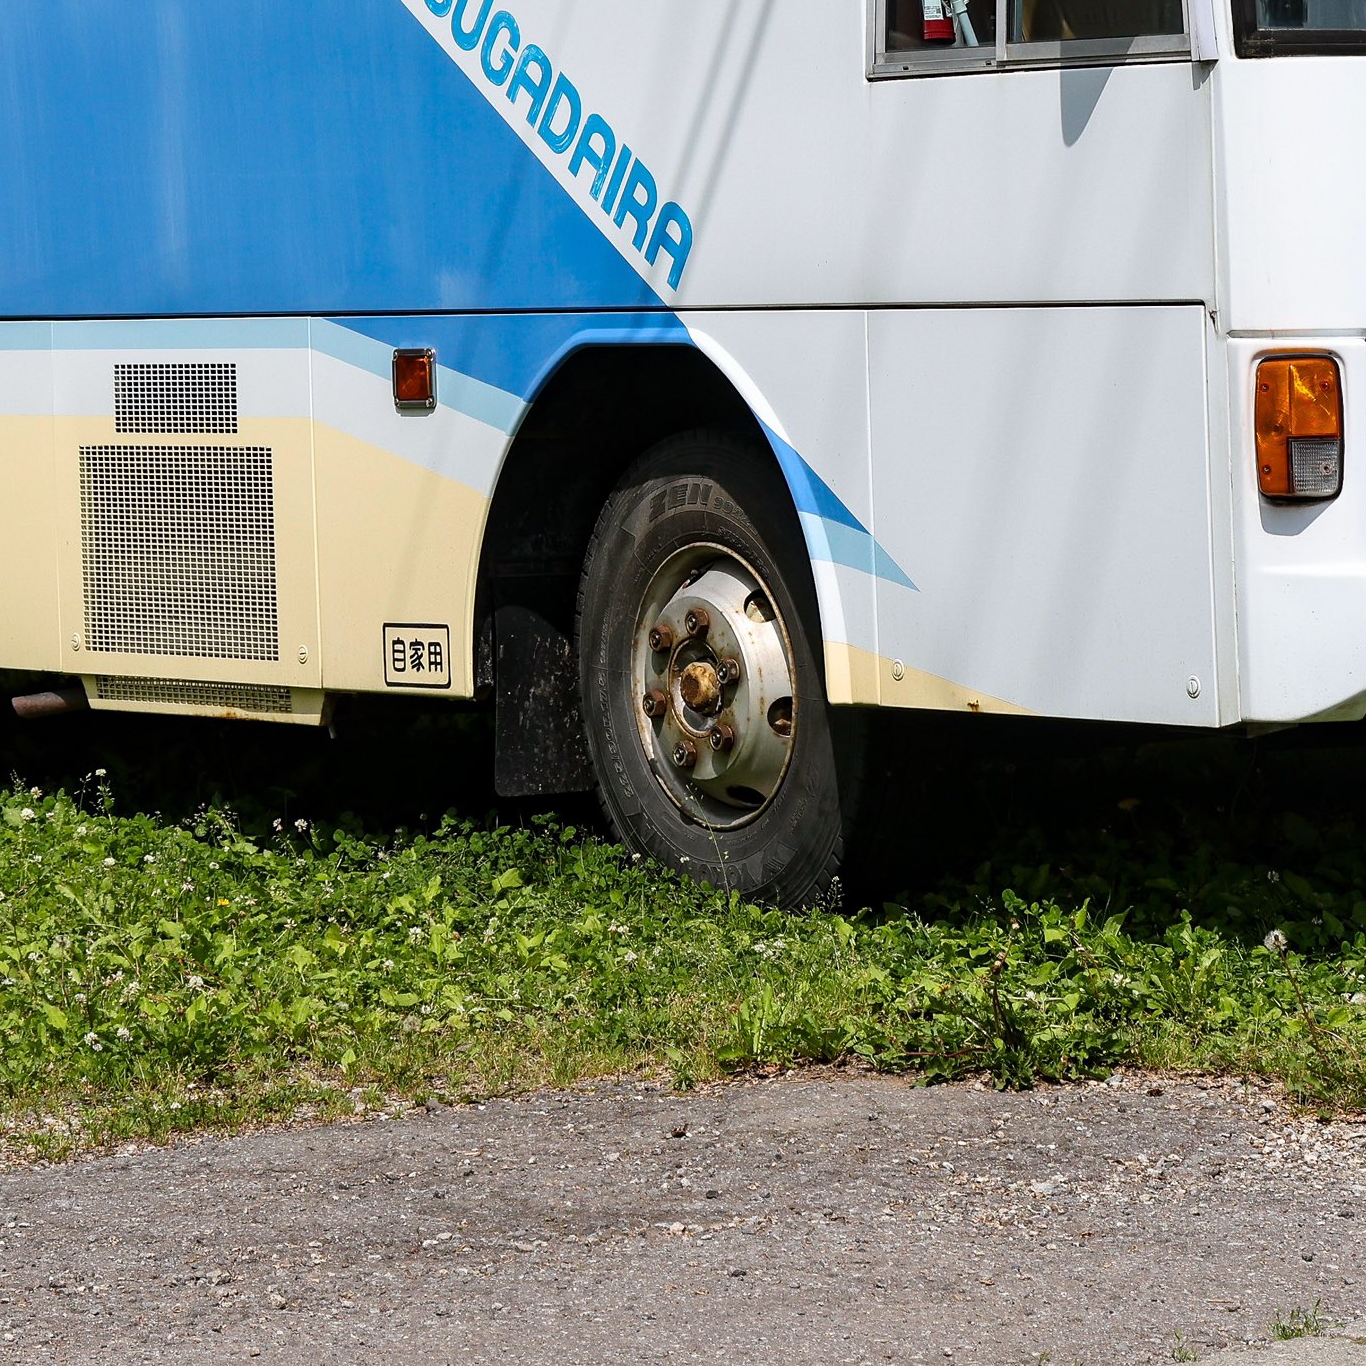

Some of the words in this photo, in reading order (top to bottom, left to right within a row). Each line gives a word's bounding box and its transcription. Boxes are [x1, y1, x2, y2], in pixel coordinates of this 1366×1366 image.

[649, 483, 713, 523] ZEN
[391, 636, 444, 674] 自家用
